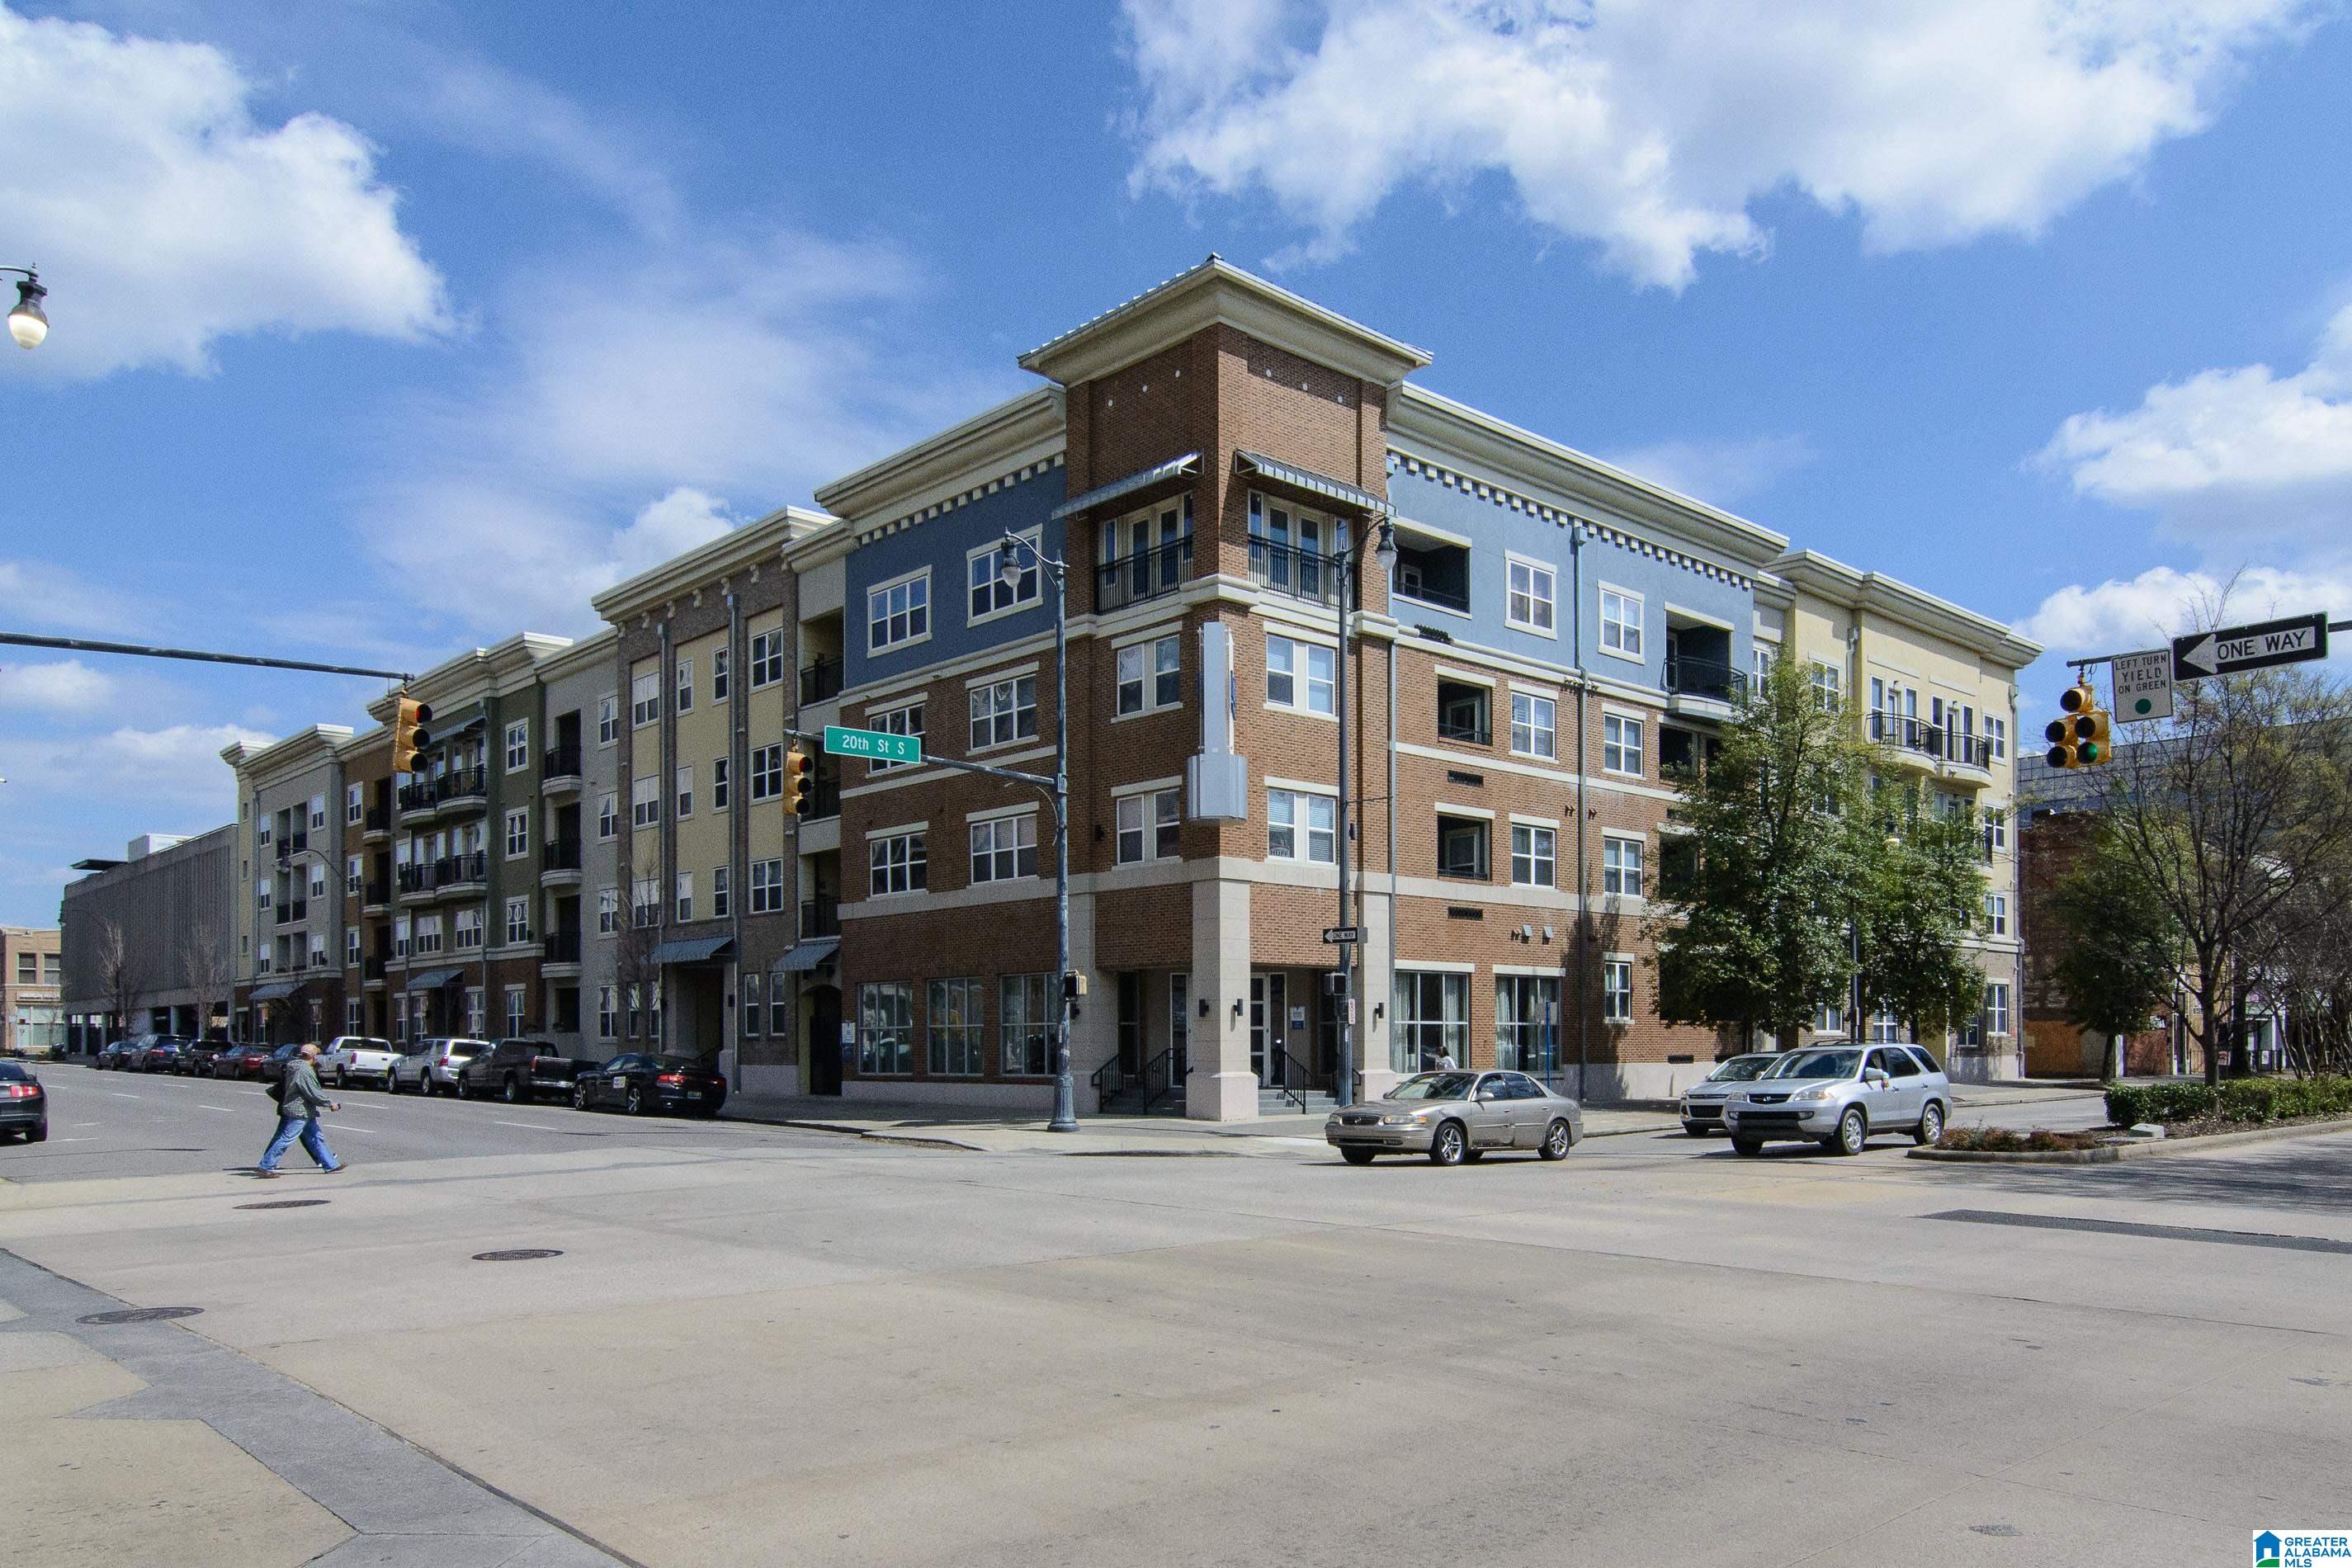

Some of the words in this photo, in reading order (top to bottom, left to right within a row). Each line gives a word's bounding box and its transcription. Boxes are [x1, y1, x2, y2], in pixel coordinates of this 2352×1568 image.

[2217, 639, 2255, 660] ONE
[2265, 631, 2307, 653] WAY
[2115, 658, 2139, 671] LEFT
[2142, 654, 2167, 666] TURN
[2122, 667, 2162, 681] YIELD
[2118, 684, 2131, 694] ON
[2136, 679, 2166, 692] GREEN
[842, 734, 869, 751] 20th
[877, 739, 890, 753] St
[898, 742, 904, 755] S
